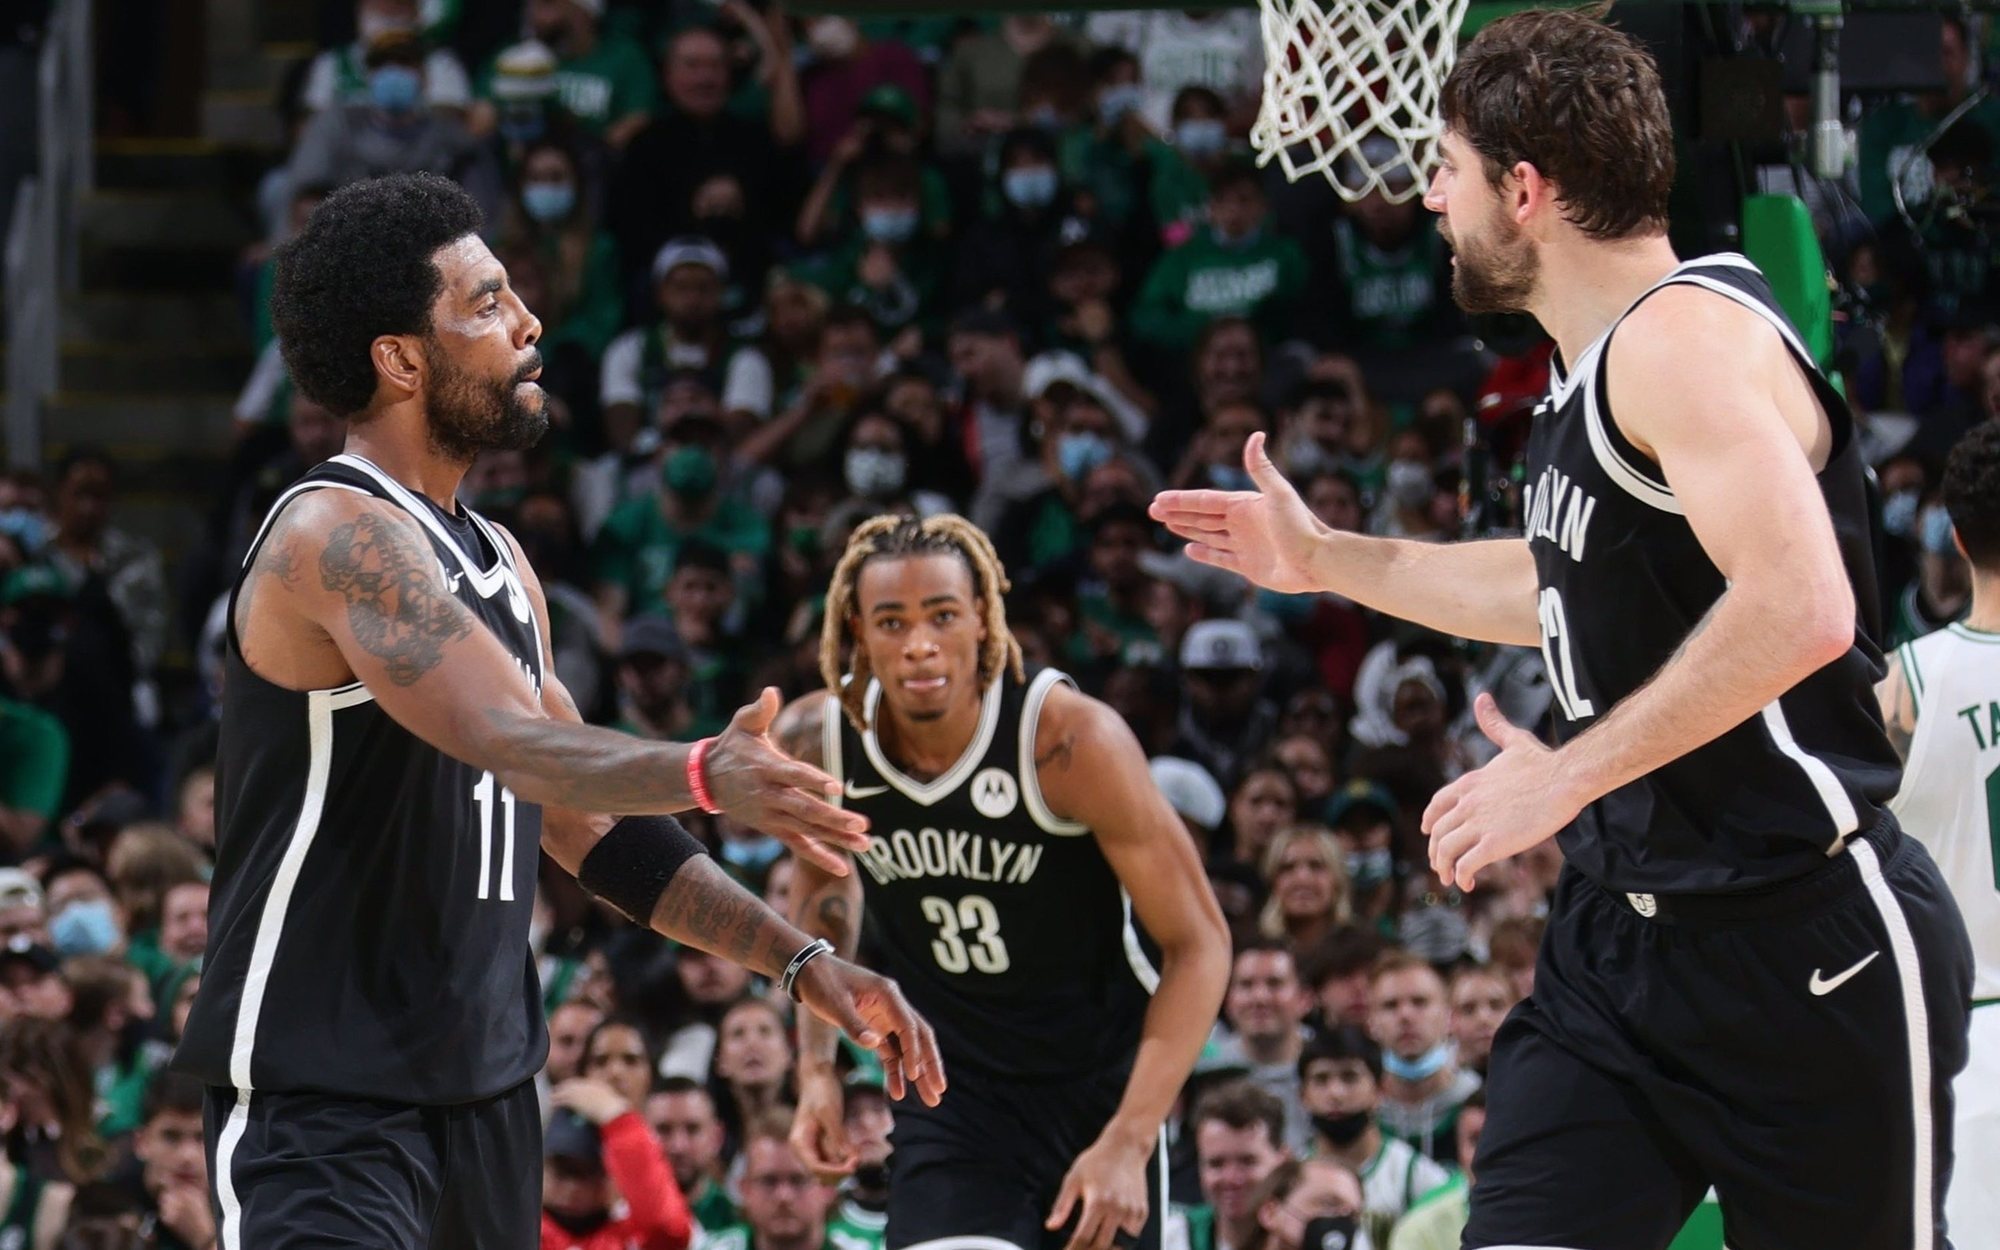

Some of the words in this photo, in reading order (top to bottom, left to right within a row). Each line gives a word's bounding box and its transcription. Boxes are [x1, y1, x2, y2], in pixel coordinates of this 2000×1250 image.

[1538, 586, 1595, 722] 12
[473, 769, 516, 901] 11
[920, 895, 1010, 974] 33
